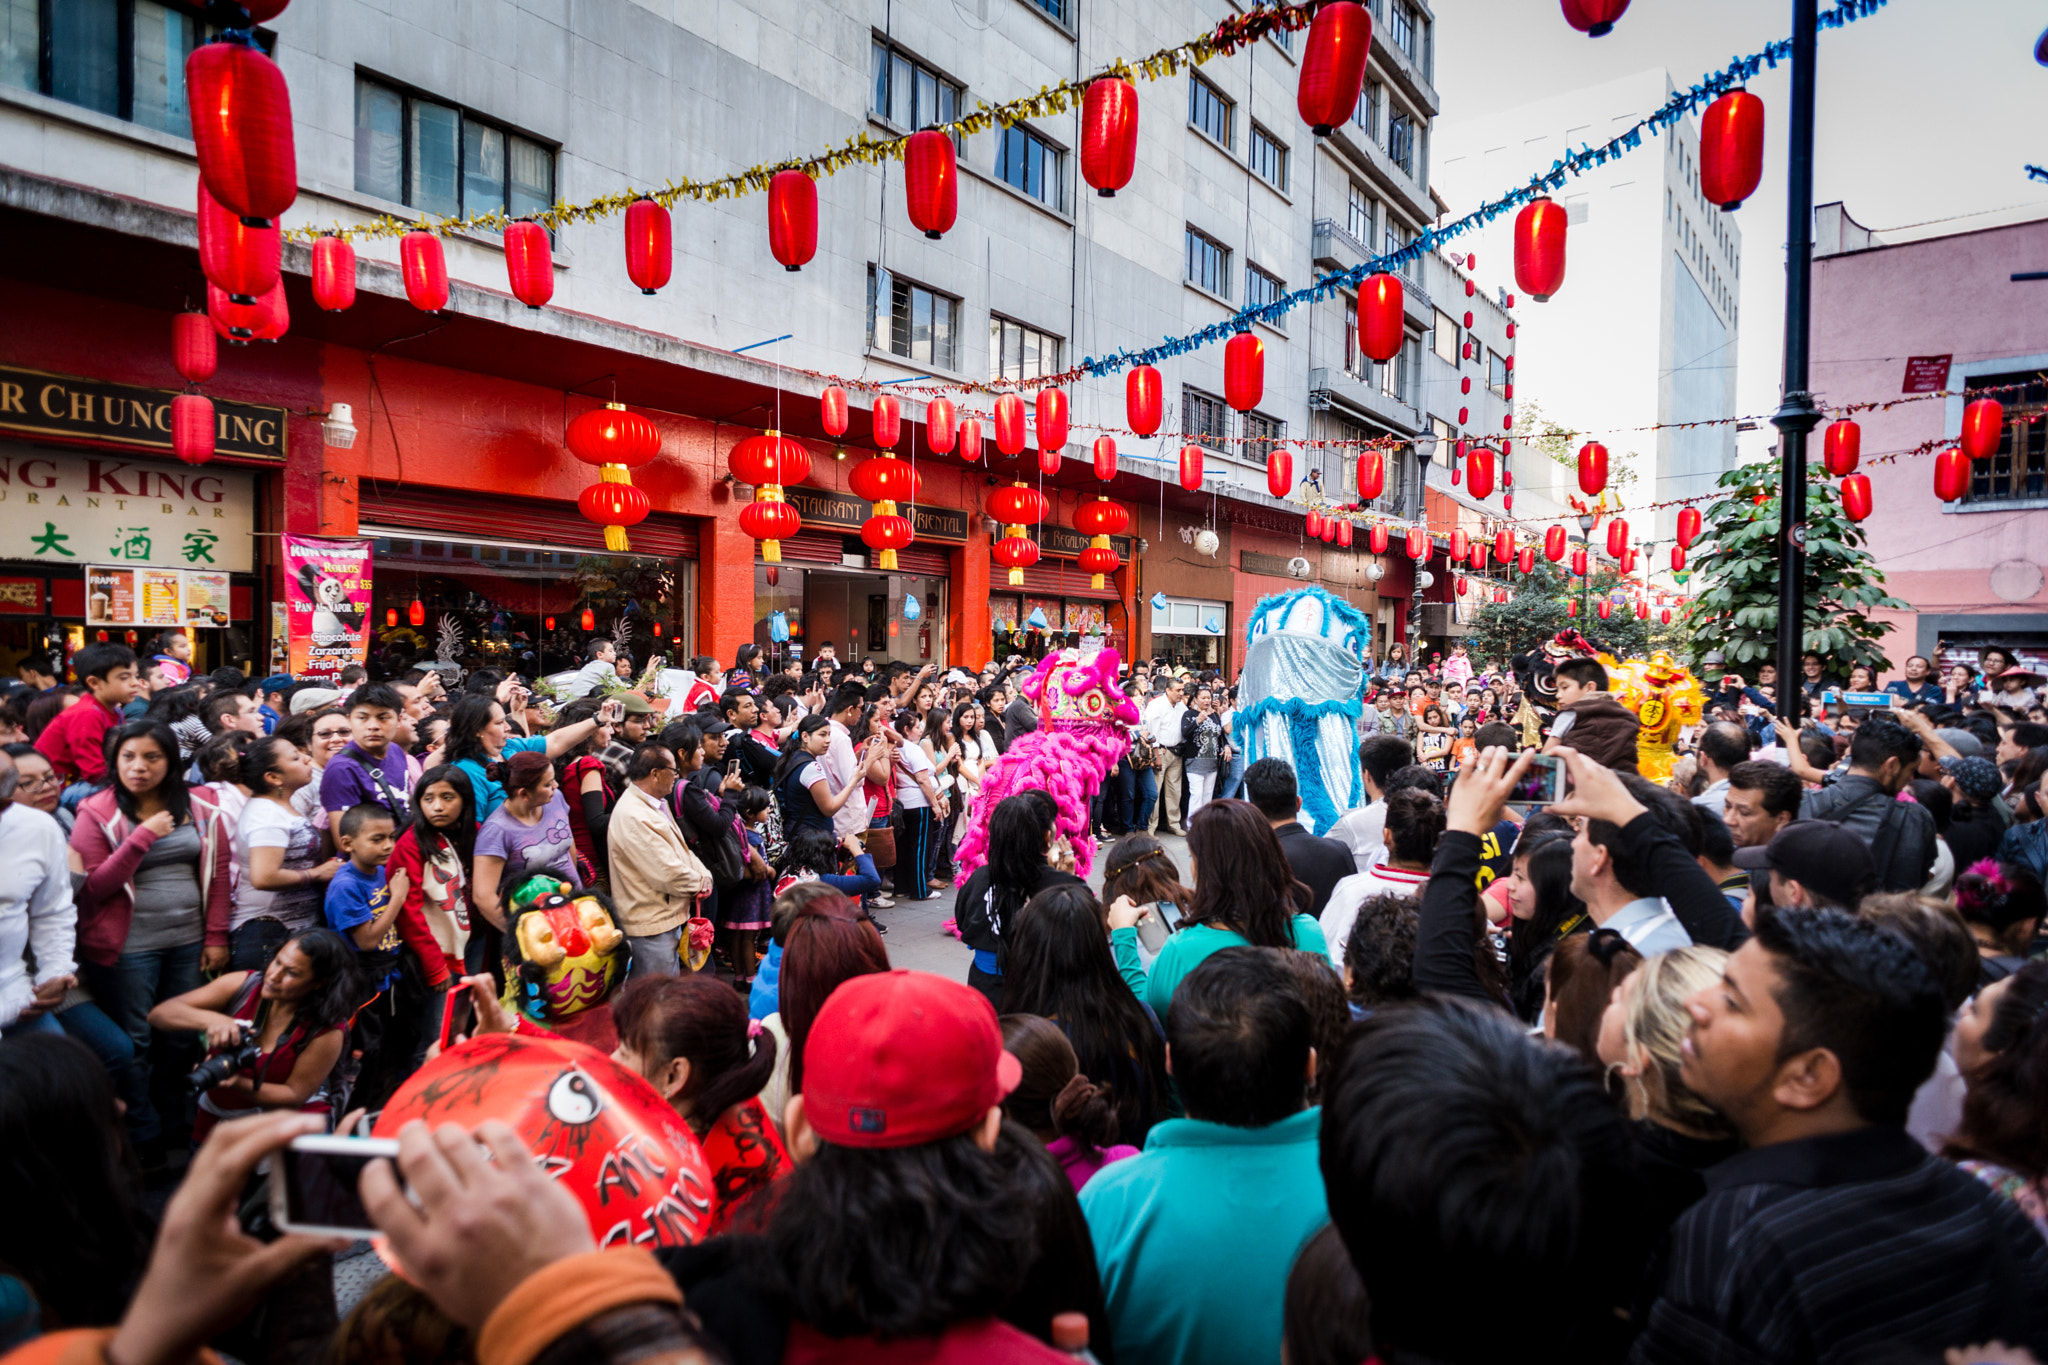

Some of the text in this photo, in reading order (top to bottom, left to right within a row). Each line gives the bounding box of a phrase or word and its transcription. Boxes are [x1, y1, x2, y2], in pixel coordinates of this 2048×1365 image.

[39, 383, 171, 433] CHUNG
[217, 413, 276, 446] ING
[83, 458, 226, 504] KING
[161, 502, 225, 519] BAR
[783, 493, 962, 534] ESTAURANT ORIENTAL
[1053, 530, 1090, 549] REGALOS
[323, 561, 360, 574] ROLLOS
[89, 575, 121, 585] FRAPPÉ
[295, 601, 312, 612] PAN
[329, 601, 352, 613] VAPOR
[310, 632, 362, 642] Chocolate
[308, 646, 362, 656] Zarzamora
[308, 659, 334, 671] Frijol
